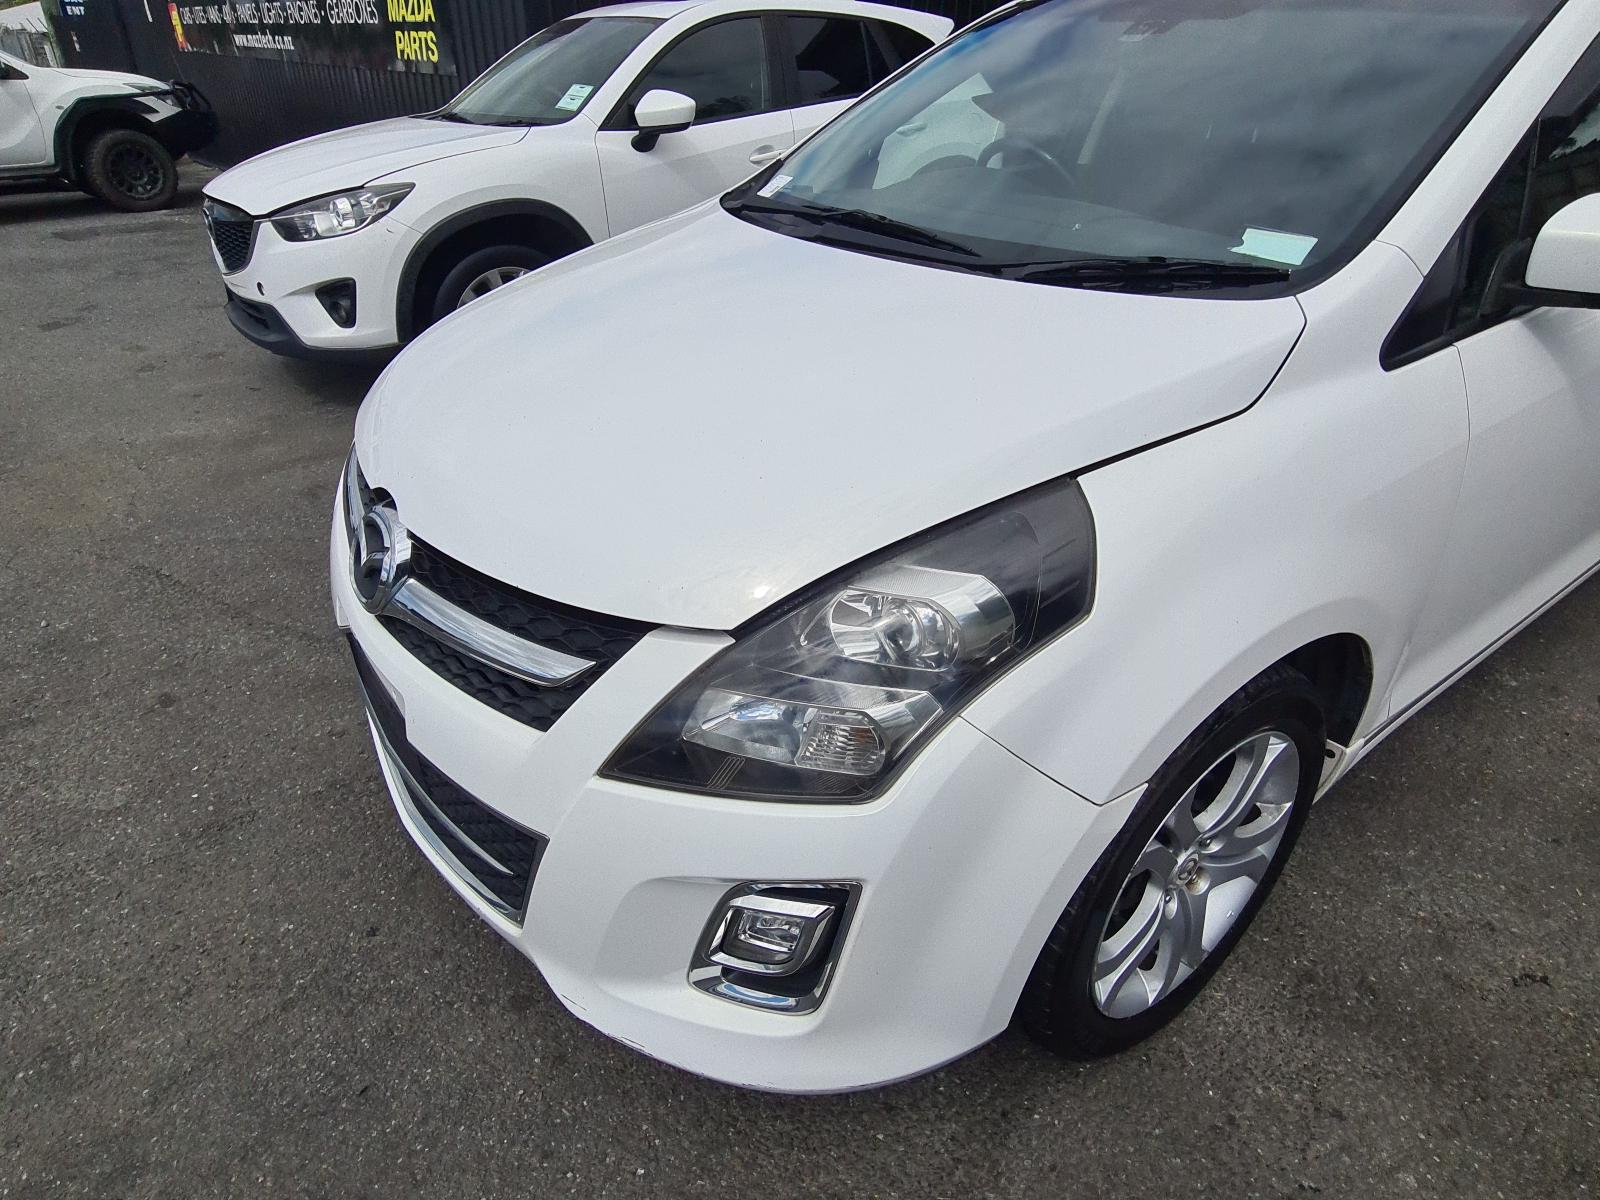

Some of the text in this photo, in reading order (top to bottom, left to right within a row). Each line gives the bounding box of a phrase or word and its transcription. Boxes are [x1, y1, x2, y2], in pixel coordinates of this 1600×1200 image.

[180, 7, 193, 24] CARS
[206, 5, 221, 24] VANS
[236, 3, 258, 24] PANELS
[260, 2, 283, 24] LIGHTS
[286, 0, 320, 24] ENGINES
[326, 0, 379, 24] GEARBOXES
[386, 0, 436, 23] MAZDA
[395, 30, 439, 64] PARTS
